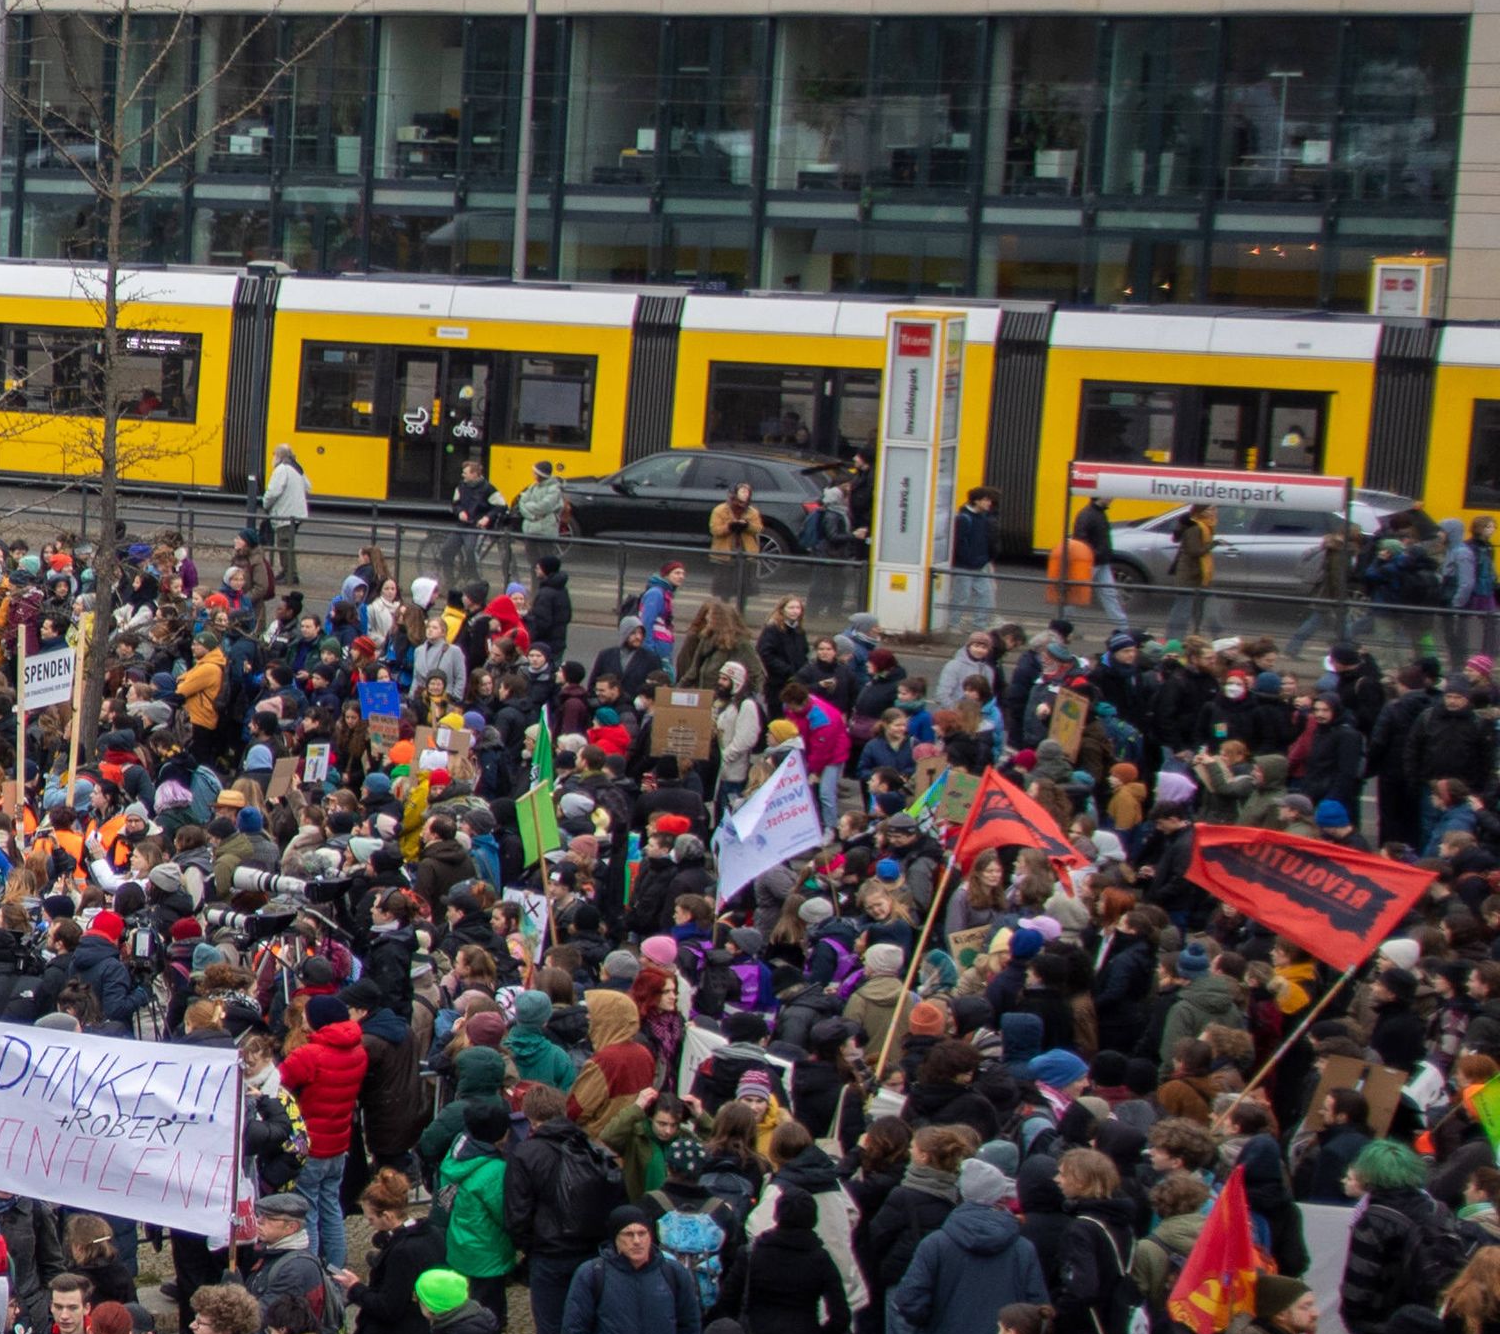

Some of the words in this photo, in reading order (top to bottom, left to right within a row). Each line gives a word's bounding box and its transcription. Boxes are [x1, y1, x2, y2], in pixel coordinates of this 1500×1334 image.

[900, 333, 930, 346] Tram
[905, 368, 918, 435] Invalidenpark
[1073, 470, 1097, 480] Tram
[1152, 478, 1285, 503] Invalidenpark
[24, 656, 71, 685] SPENDEN
[56, 1107, 199, 1145] +ROBERT
